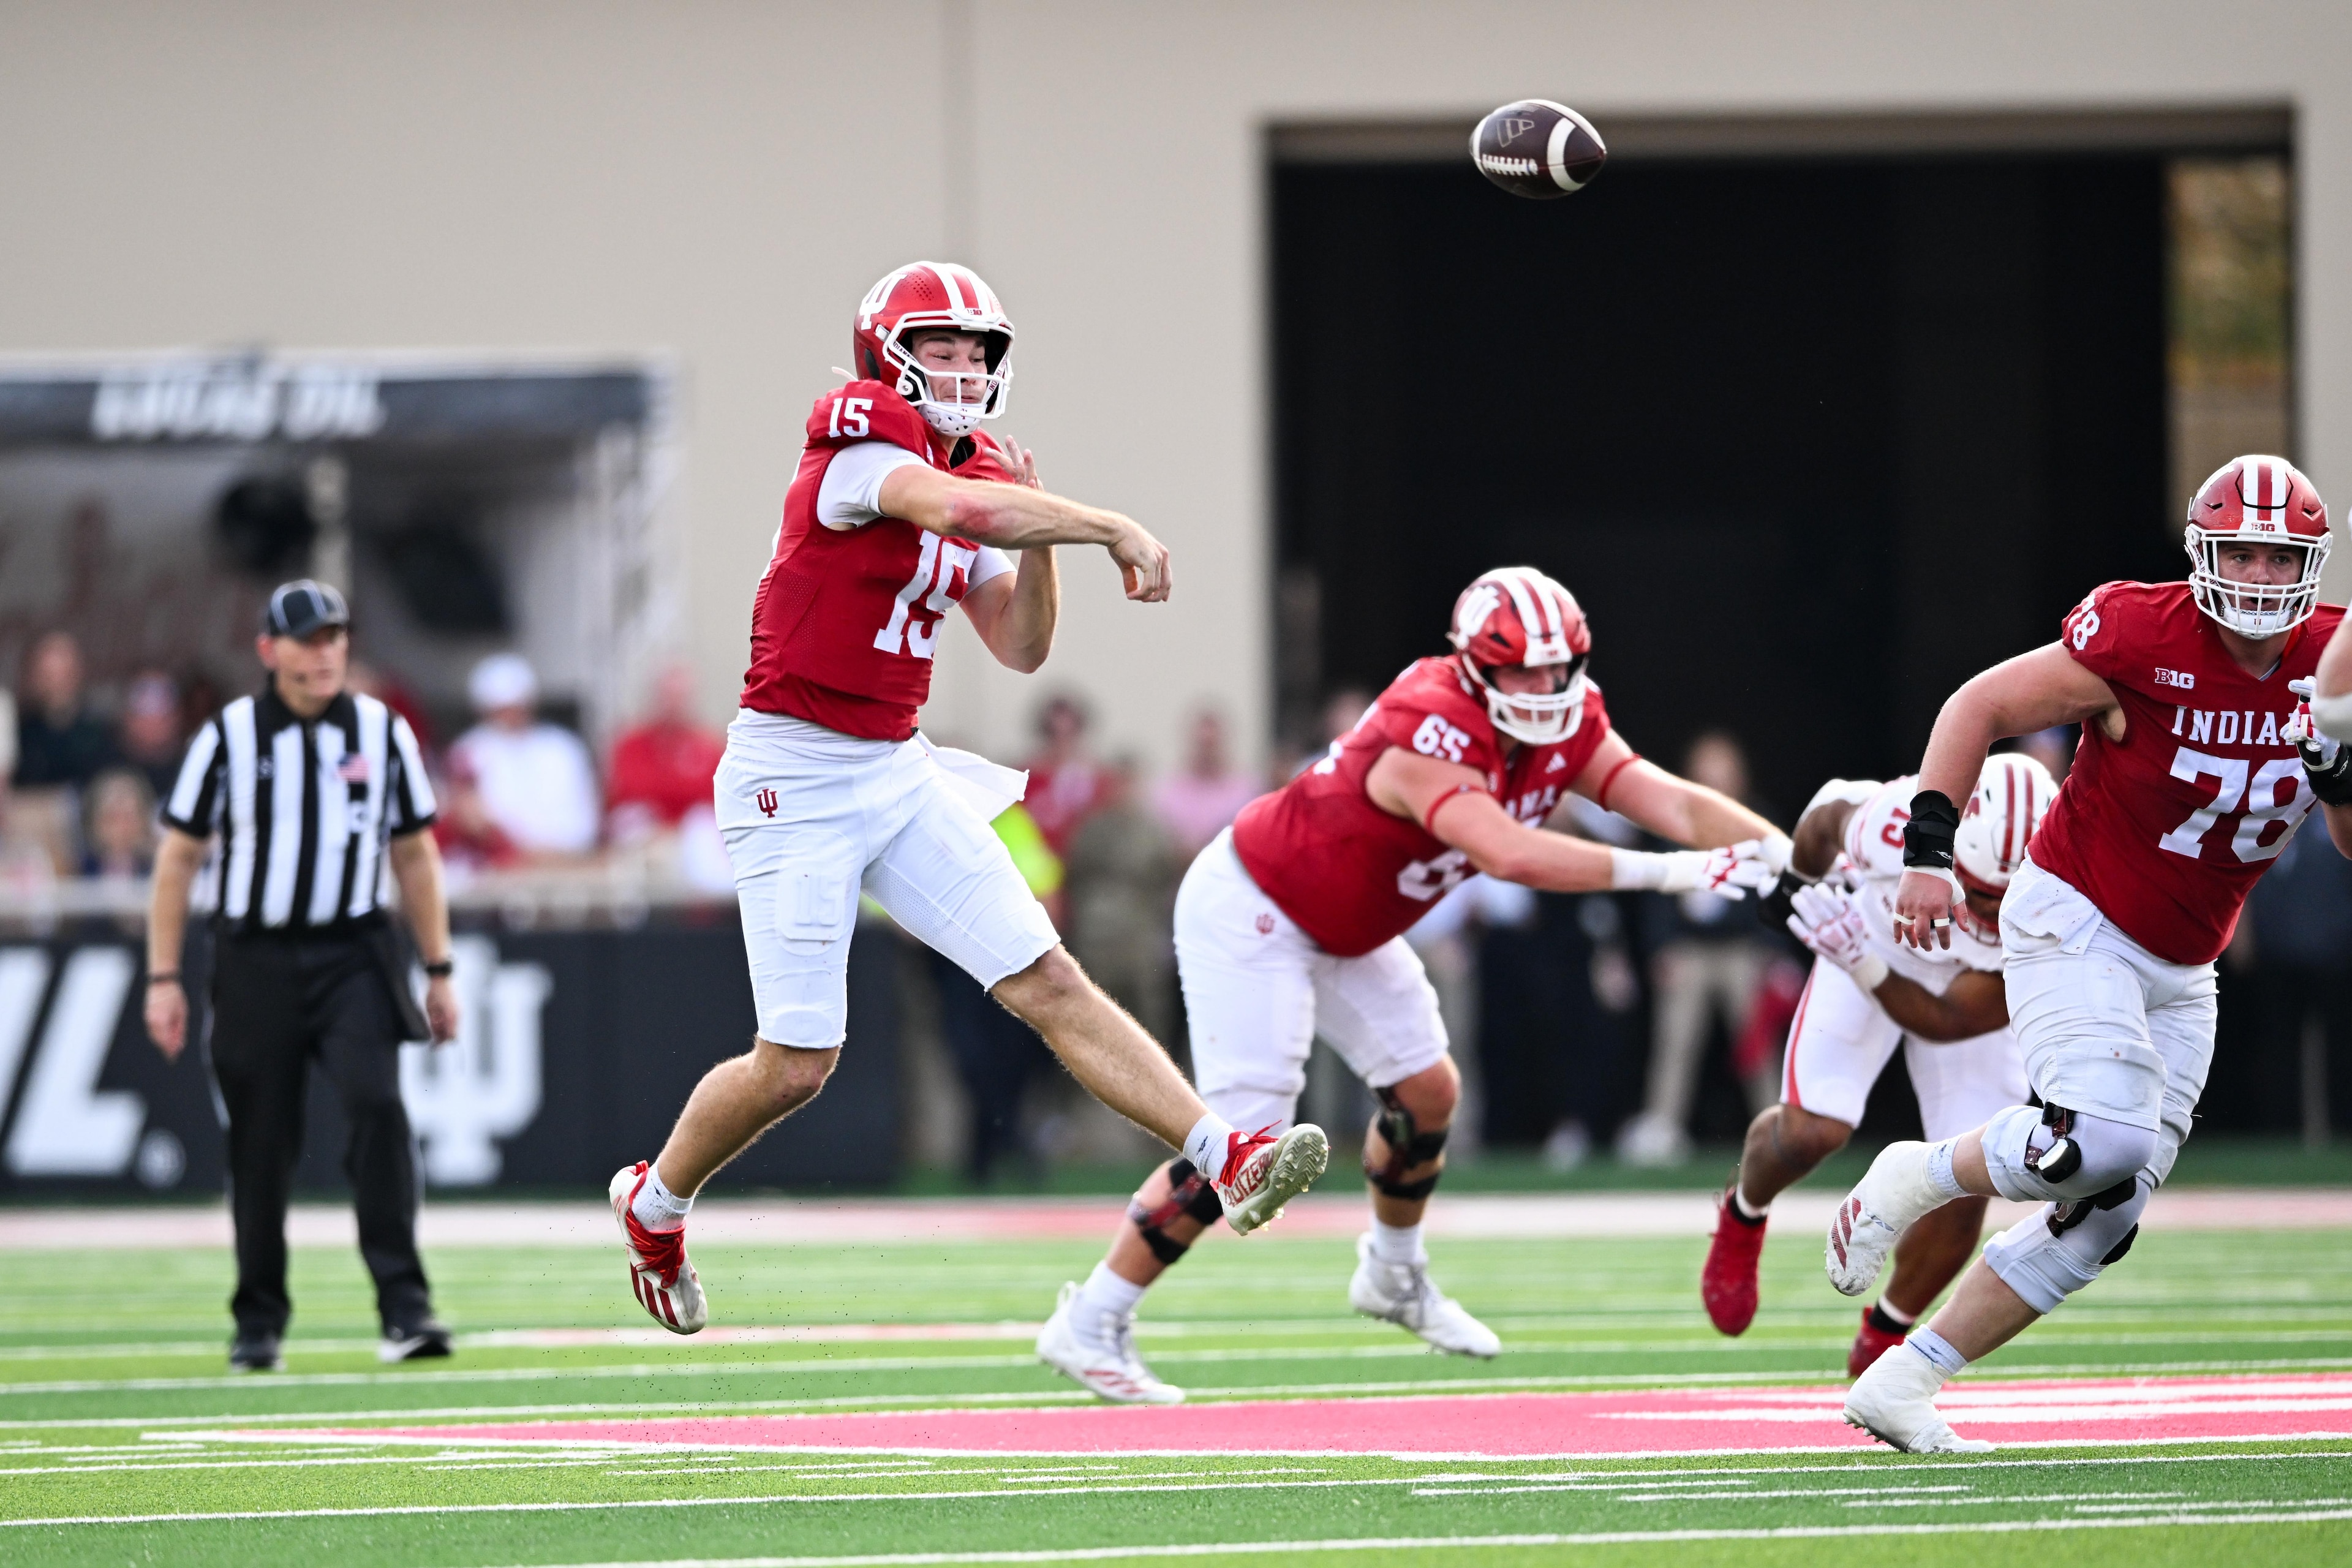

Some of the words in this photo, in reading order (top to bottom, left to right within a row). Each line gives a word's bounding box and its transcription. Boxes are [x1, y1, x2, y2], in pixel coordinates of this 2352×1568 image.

[829, 398, 873, 437] 15
[873, 529, 978, 659] 15
[2068, 592, 2100, 650] 78
[1412, 714, 1471, 763] 65
[2171, 704, 2297, 746] INDIA
[2158, 745, 2318, 864] 78
